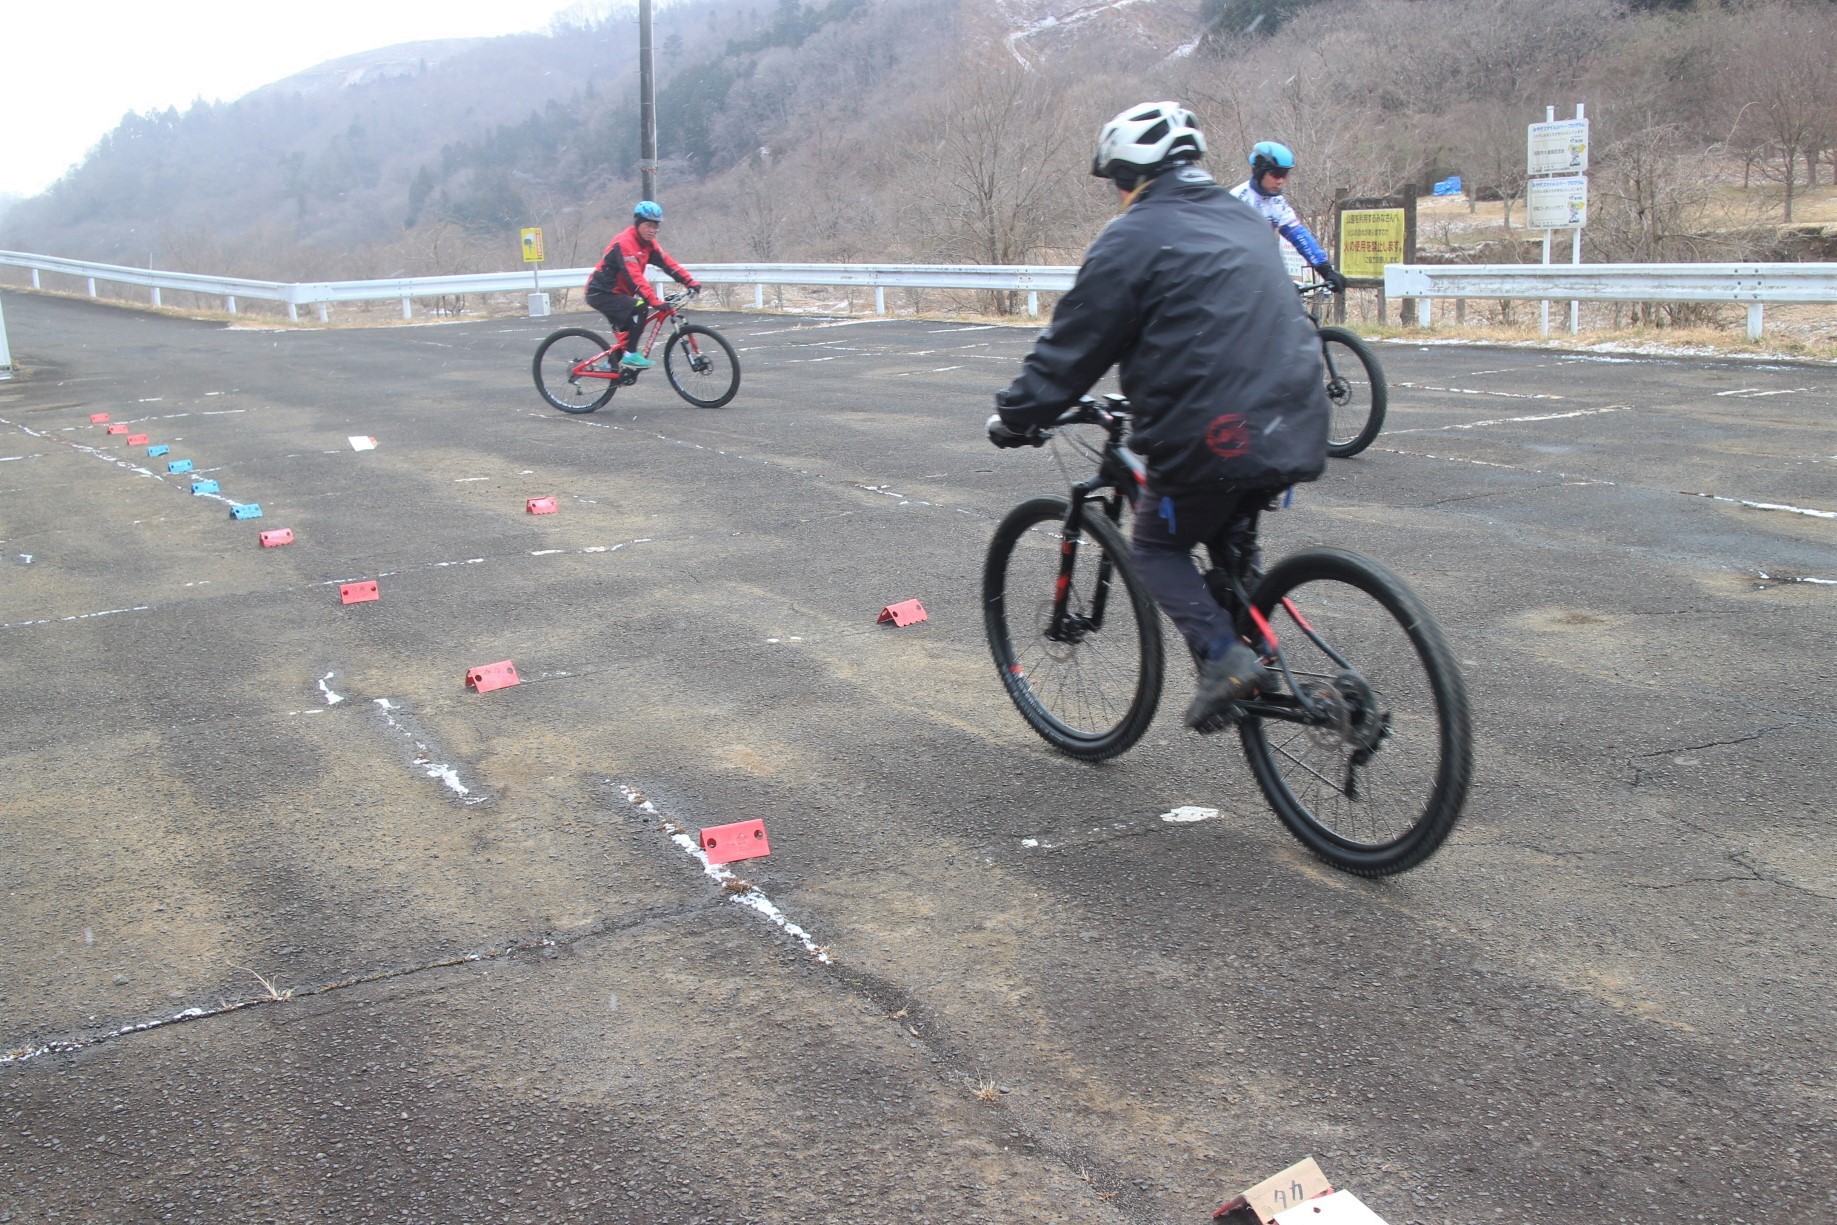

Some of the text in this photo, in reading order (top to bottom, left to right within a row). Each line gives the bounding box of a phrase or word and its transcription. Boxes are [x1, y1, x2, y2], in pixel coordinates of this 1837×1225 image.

[1343, 240, 1402, 253] 火の使用を禁止します。
